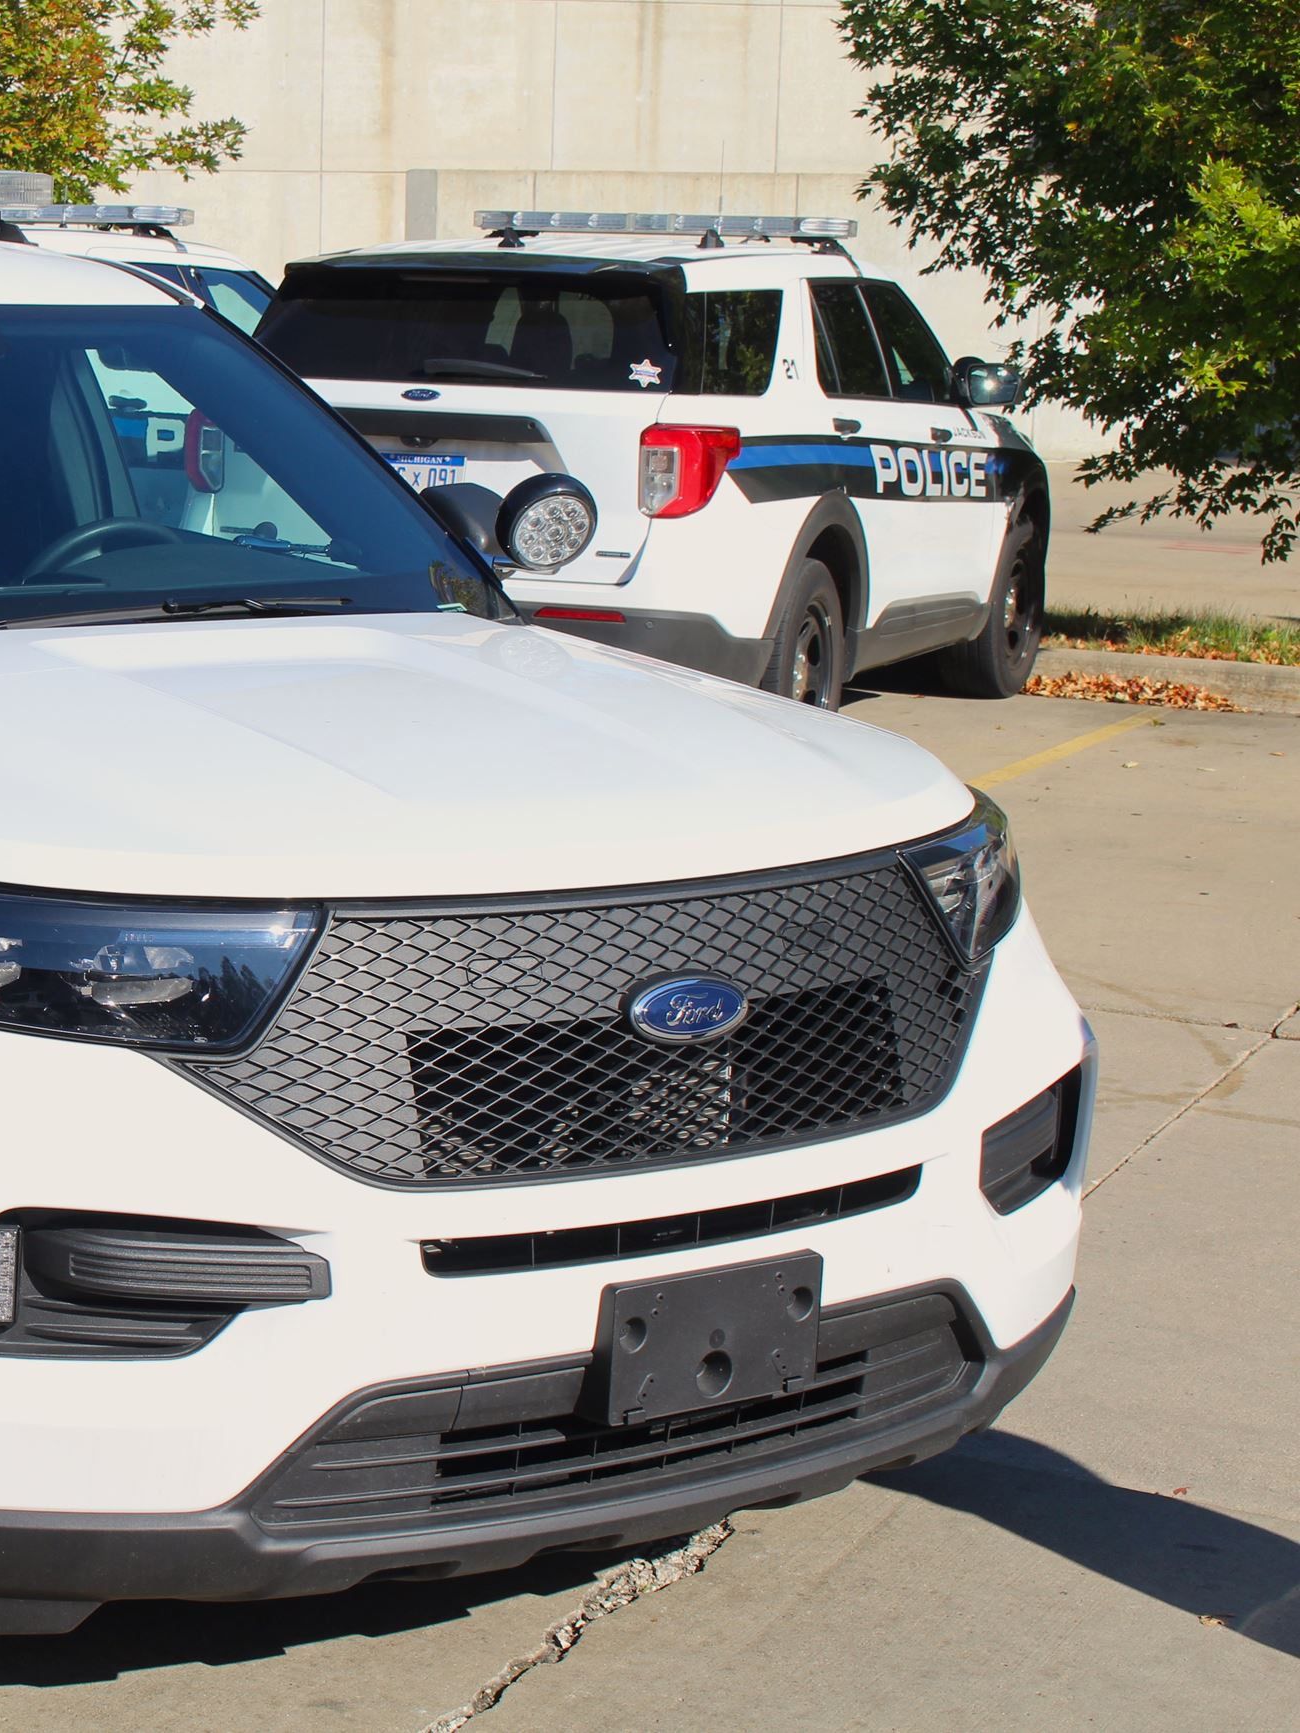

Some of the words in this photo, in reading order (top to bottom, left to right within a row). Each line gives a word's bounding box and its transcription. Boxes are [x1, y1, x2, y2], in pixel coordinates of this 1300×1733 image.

[782, 358, 799, 380] 21
[396, 455, 443, 464] MICHIGAN
[869, 444, 989, 497] POLICE
[427, 468, 457, 488] 091
[666, 992, 723, 1027] Ford
